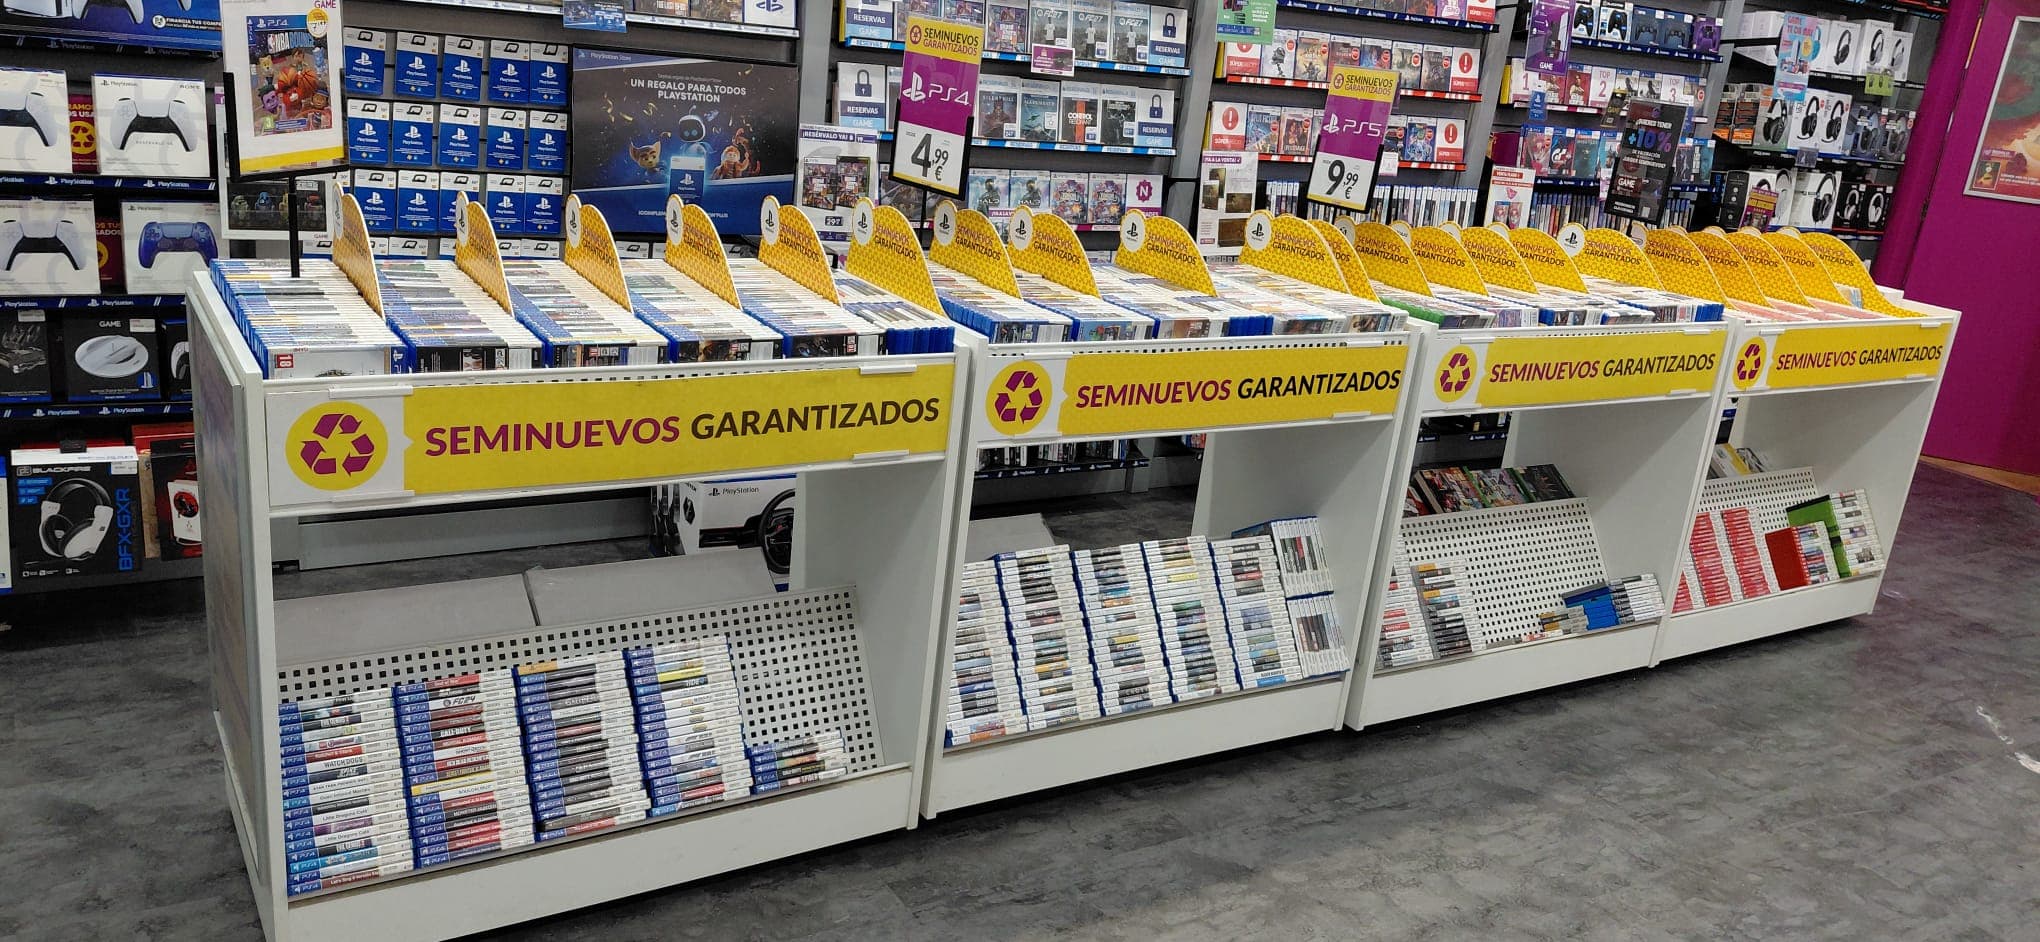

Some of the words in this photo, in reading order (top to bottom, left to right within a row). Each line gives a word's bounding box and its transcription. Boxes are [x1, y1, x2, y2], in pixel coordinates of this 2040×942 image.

[315, 0, 336, 9] GAME
[267, 19, 289, 27] PS4
[853, 14, 886, 24] RESERVAS
[275, 33, 290, 49] NBA
[924, 28, 979, 46] SEMINUEVOS
[590, 52, 617, 60] PlayStation
[923, 39, 977, 56] GARANTIZADOS
[1154, 45, 1182, 54] RESERVAS
[630, 78, 644, 89] UN
[647, 79, 685, 91] REGALO
[687, 82, 713, 93] PARA
[714, 84, 747, 96] TODOS
[1347, 75, 1393, 87] SEMINUEVOS
[657, 90, 721, 103] PLAYSTATION
[929, 83, 970, 106] PS4
[1345, 84, 1391, 96] GARANTIZADOS
[847, 106, 879, 115] RESERVAS
[852, 119, 874, 128] GAME
[1142, 126, 1168, 135] RESERVAS
[1343, 119, 1382, 137] PS5
[802, 130, 837, 140] ¡RESÉRVALO
[1628, 128, 1672, 153] +10%
[935, 166, 944, 181] €
[1618, 178, 1635, 189] GAME
[1345, 187, 1352, 199] €
[876, 223, 910, 246] SEMINUEVOS
[957, 224, 993, 245] SEMINUEVOS
[1035, 230, 1073, 251] SEMINUEVOS
[1149, 232, 1189, 251] SEMINUEVOS
[1275, 232, 1317, 249] SEMINUEVOS
[875, 235, 918, 261] GARANTIZADOS
[956, 236, 1001, 261] GARANTIZADOS
[1273, 242, 1326, 261] GARANTIZADOS
[1358, 236, 1401, 252] SEMINUEVOS
[1414, 240, 1458, 257] SEMINUEVOS
[1033, 242, 1080, 265] GARANTIZADOS
[1147, 243, 1198, 265] GARANTIZADOS
[1775, 351, 1857, 371] SEMINUEVOS
[1858, 344, 1942, 366] GARANTIZADOS
[1489, 360, 1600, 384] SEMINUEVOS
[1602, 353, 1716, 377] GARANTIZADOS
[1075, 379, 1232, 408] SEMINUEVOS
[1236, 369, 1401, 399] GARANTIZADOS
[424, 416, 680, 458] SEMINUEVOS
[691, 397, 940, 441] GARANTIZADOS
[33, 466, 91, 474] BLACKFIRE
[723, 487, 759, 495] PlayStation
[115, 488, 133, 570] BFX-GXR
